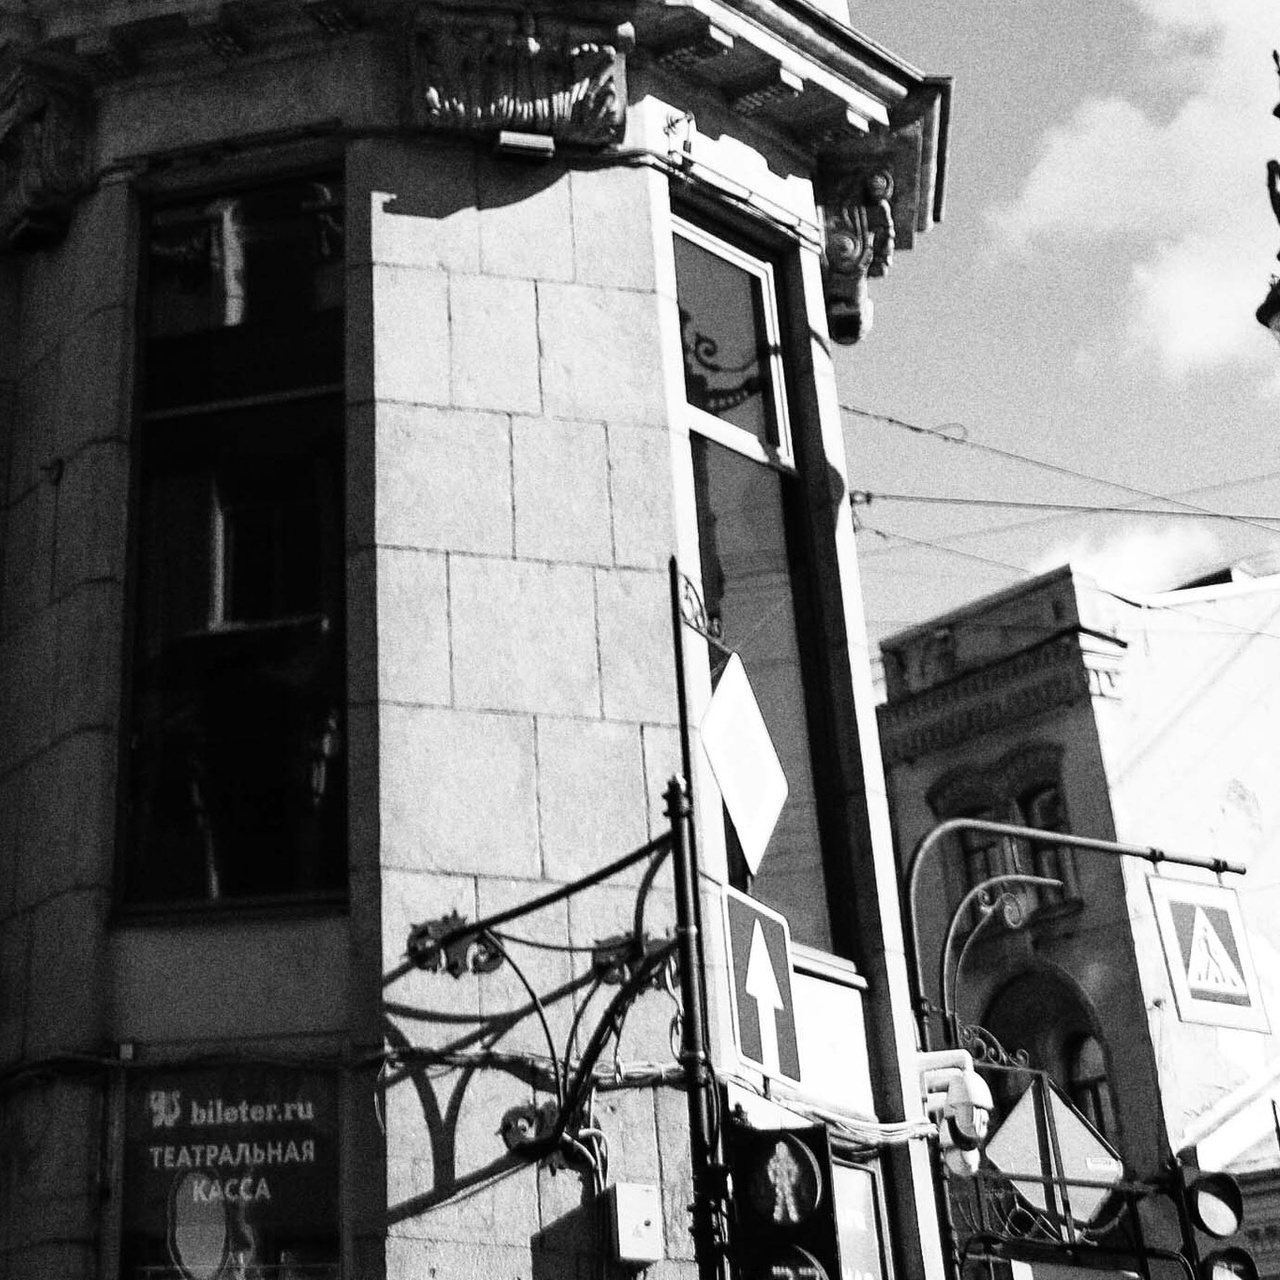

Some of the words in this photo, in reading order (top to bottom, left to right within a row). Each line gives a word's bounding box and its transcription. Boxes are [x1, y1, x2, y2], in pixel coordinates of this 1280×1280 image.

[190, 1098, 315, 1125] bileter.ru
[149, 1139, 316, 1169] ТЕАТРАЛЬНАЯ
[192, 1176, 272, 1203] КАССА
